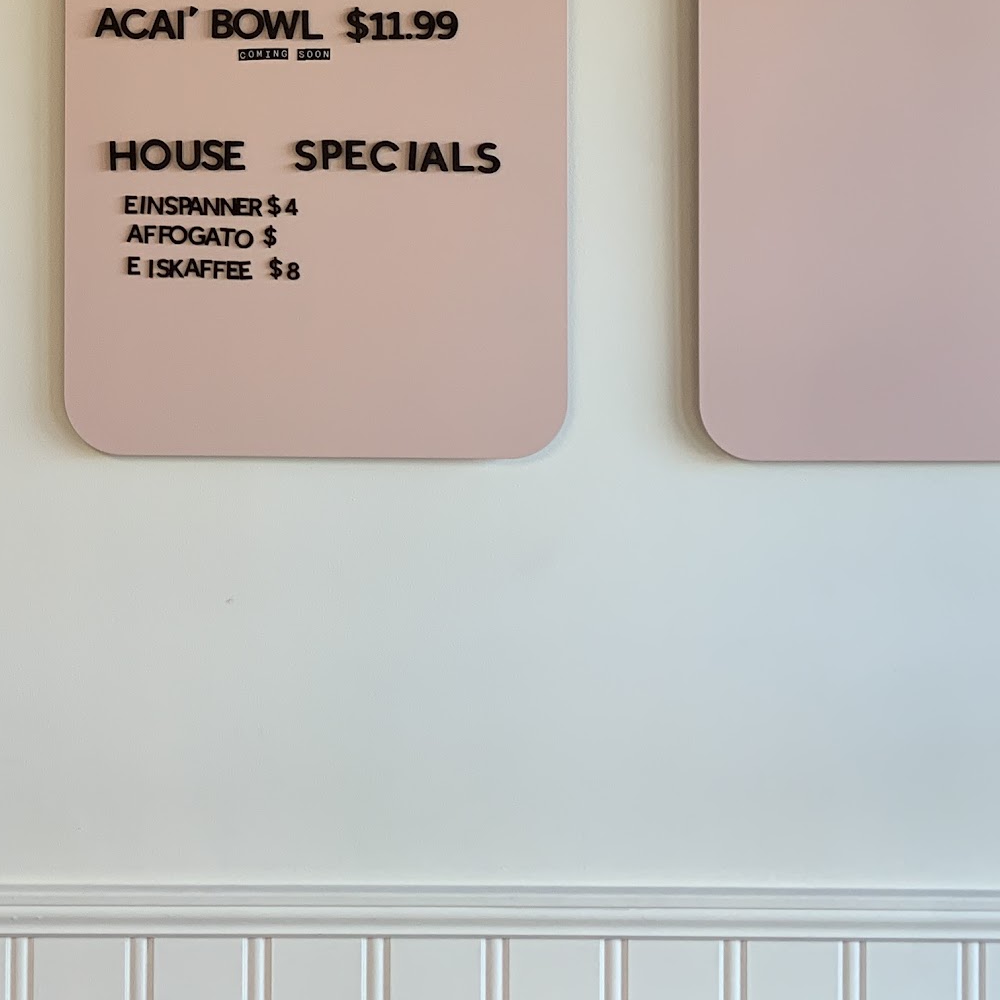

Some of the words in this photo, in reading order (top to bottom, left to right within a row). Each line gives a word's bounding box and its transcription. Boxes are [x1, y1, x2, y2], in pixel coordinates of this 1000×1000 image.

[210, 8, 324, 41] BOWL
[345, 6, 459, 44] $11.99
[239, 49, 288, 60] COMING
[298, 49, 330, 60] SOON
[108, 138, 246, 172] HOUSE
[294, 139, 501, 175] SPECIALS
[124, 195, 263, 218] EINSPANNER
[266, 193, 299, 218] $4
[126, 223, 255, 249] AFFOGATO
[262, 224, 277, 249] $
[268, 256, 301, 281] $8
